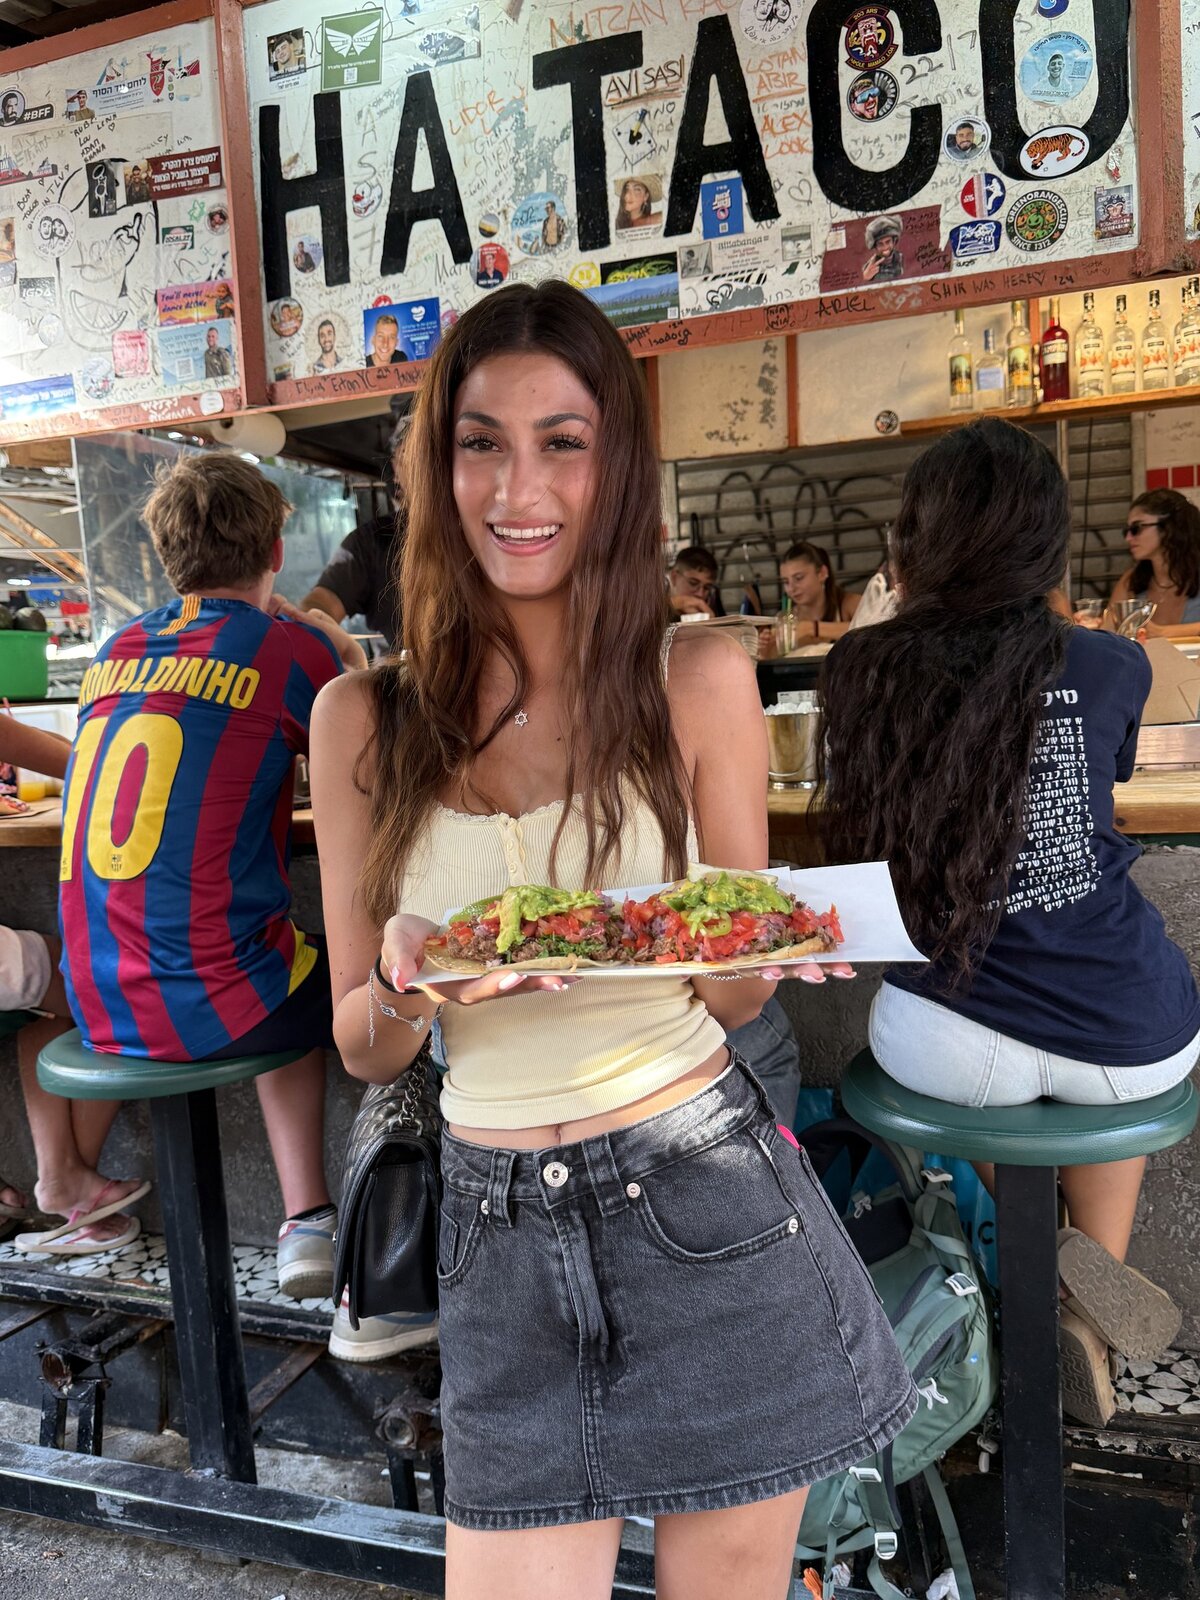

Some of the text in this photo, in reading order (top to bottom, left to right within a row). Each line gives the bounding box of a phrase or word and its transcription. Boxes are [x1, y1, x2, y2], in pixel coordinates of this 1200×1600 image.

[605, 70, 641, 100] AVI
[23, 106, 51, 121] #BFF
[258, 0, 1130, 303] HA TACO
[1011, 235, 1032, 251] SINCE
[931, 280, 966, 300] SHIR
[973, 279, 996, 294] WAS
[60, 713, 184, 882] 10
